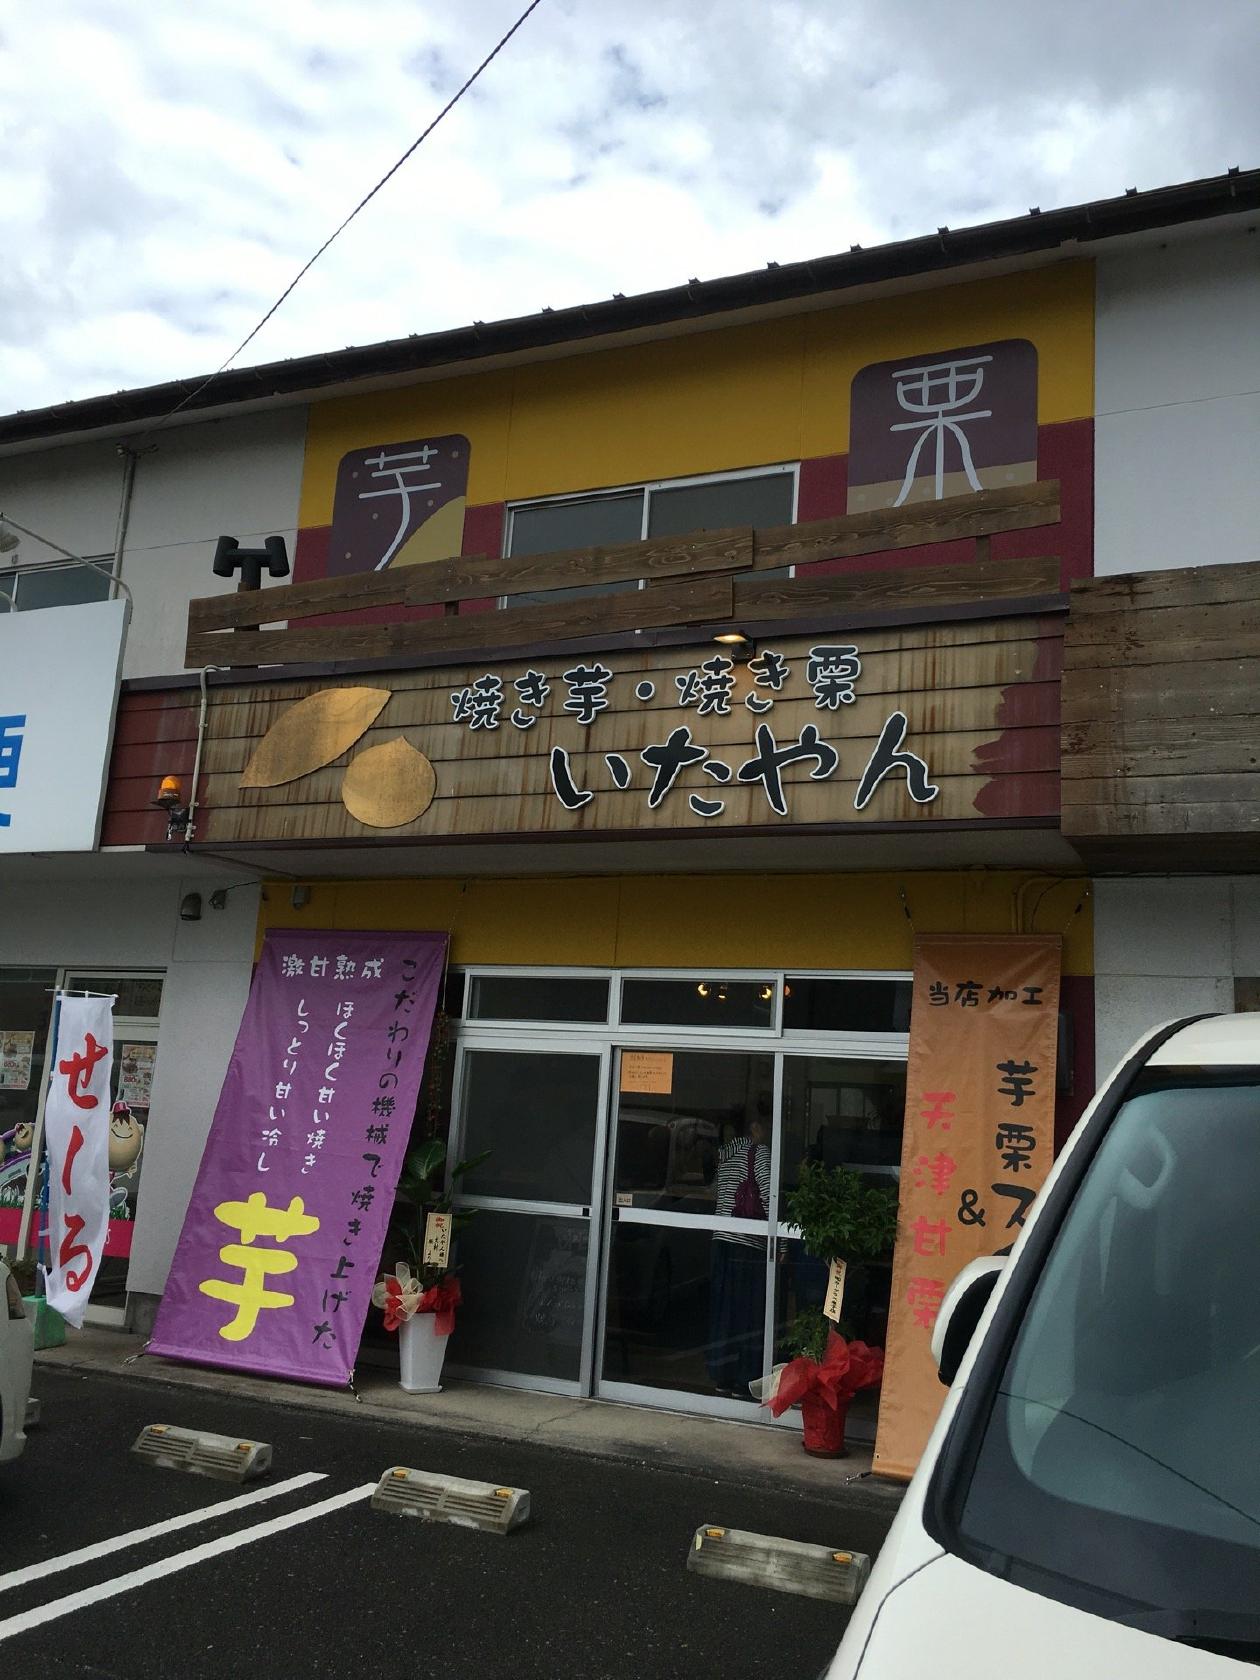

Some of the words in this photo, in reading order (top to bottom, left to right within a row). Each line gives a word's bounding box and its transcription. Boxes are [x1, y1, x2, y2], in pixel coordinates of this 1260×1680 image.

[889, 354, 993, 508] 栗
[451, 644, 862, 730] 焼き芋・焼き栗
[550, 711, 940, 816] いたやん
[281, 953, 385, 980] 激甘熟成
[928, 980, 1043, 1008] 当店加工
[59, 1032, 109, 1292] せーる
[257, 999, 310, 1173] しっとり甘い冷し
[301, 1001, 354, 1175] ほくほく甘い焼き
[312, 959, 417, 1350] こだわりの機械で焼き上げた
[991, 1059, 1038, 1257] 芋栗ス
[199, 1191, 321, 1342] 芋
[907, 1091, 957, 1329] 天津甘栗
[957, 1188, 986, 1227] &
